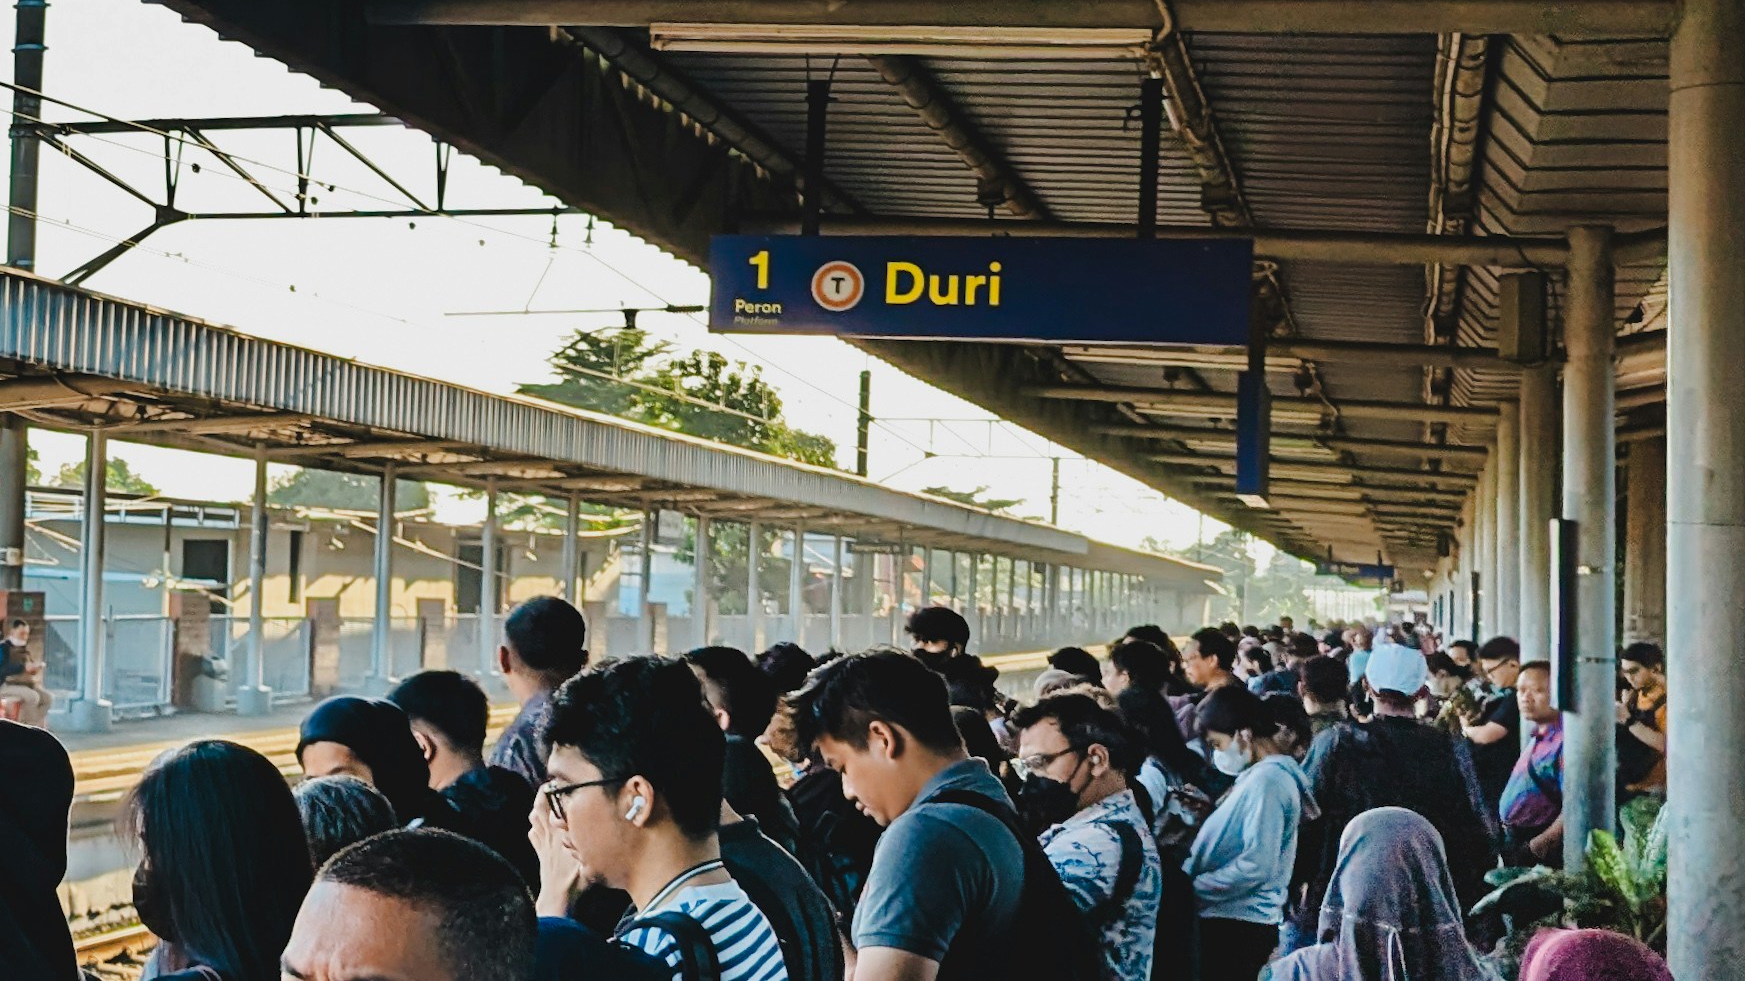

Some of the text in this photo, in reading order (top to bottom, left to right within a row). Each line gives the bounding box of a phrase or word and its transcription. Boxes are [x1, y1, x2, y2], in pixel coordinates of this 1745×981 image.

[748, 250, 769, 289] 1
[885, 261, 1002, 306] Duri
[735, 298, 782, 314] Peron
